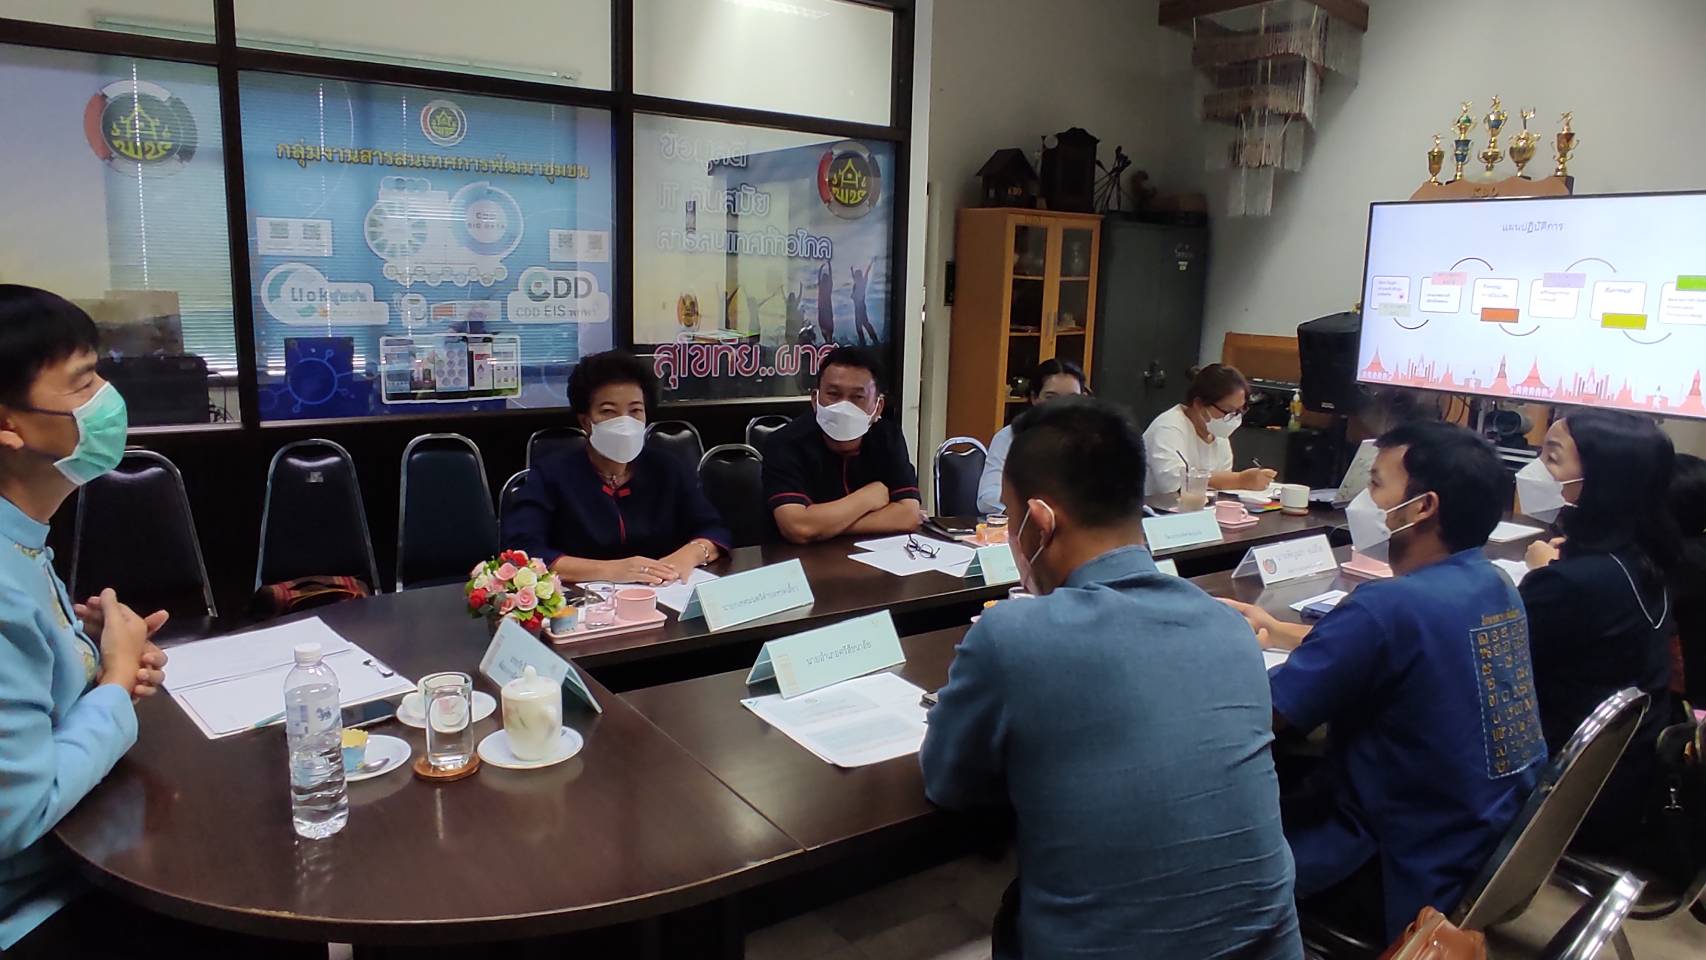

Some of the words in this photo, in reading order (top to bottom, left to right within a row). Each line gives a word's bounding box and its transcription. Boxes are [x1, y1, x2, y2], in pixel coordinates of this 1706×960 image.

[276, 139, 590, 183] กลุ่มงานสารสนเทศการพัฒนาชุมชน
[1501, 221, 1564, 234] แผนปฏิบัติการ
[656, 228, 833, 260] สารสนเทศก้าวไกล
